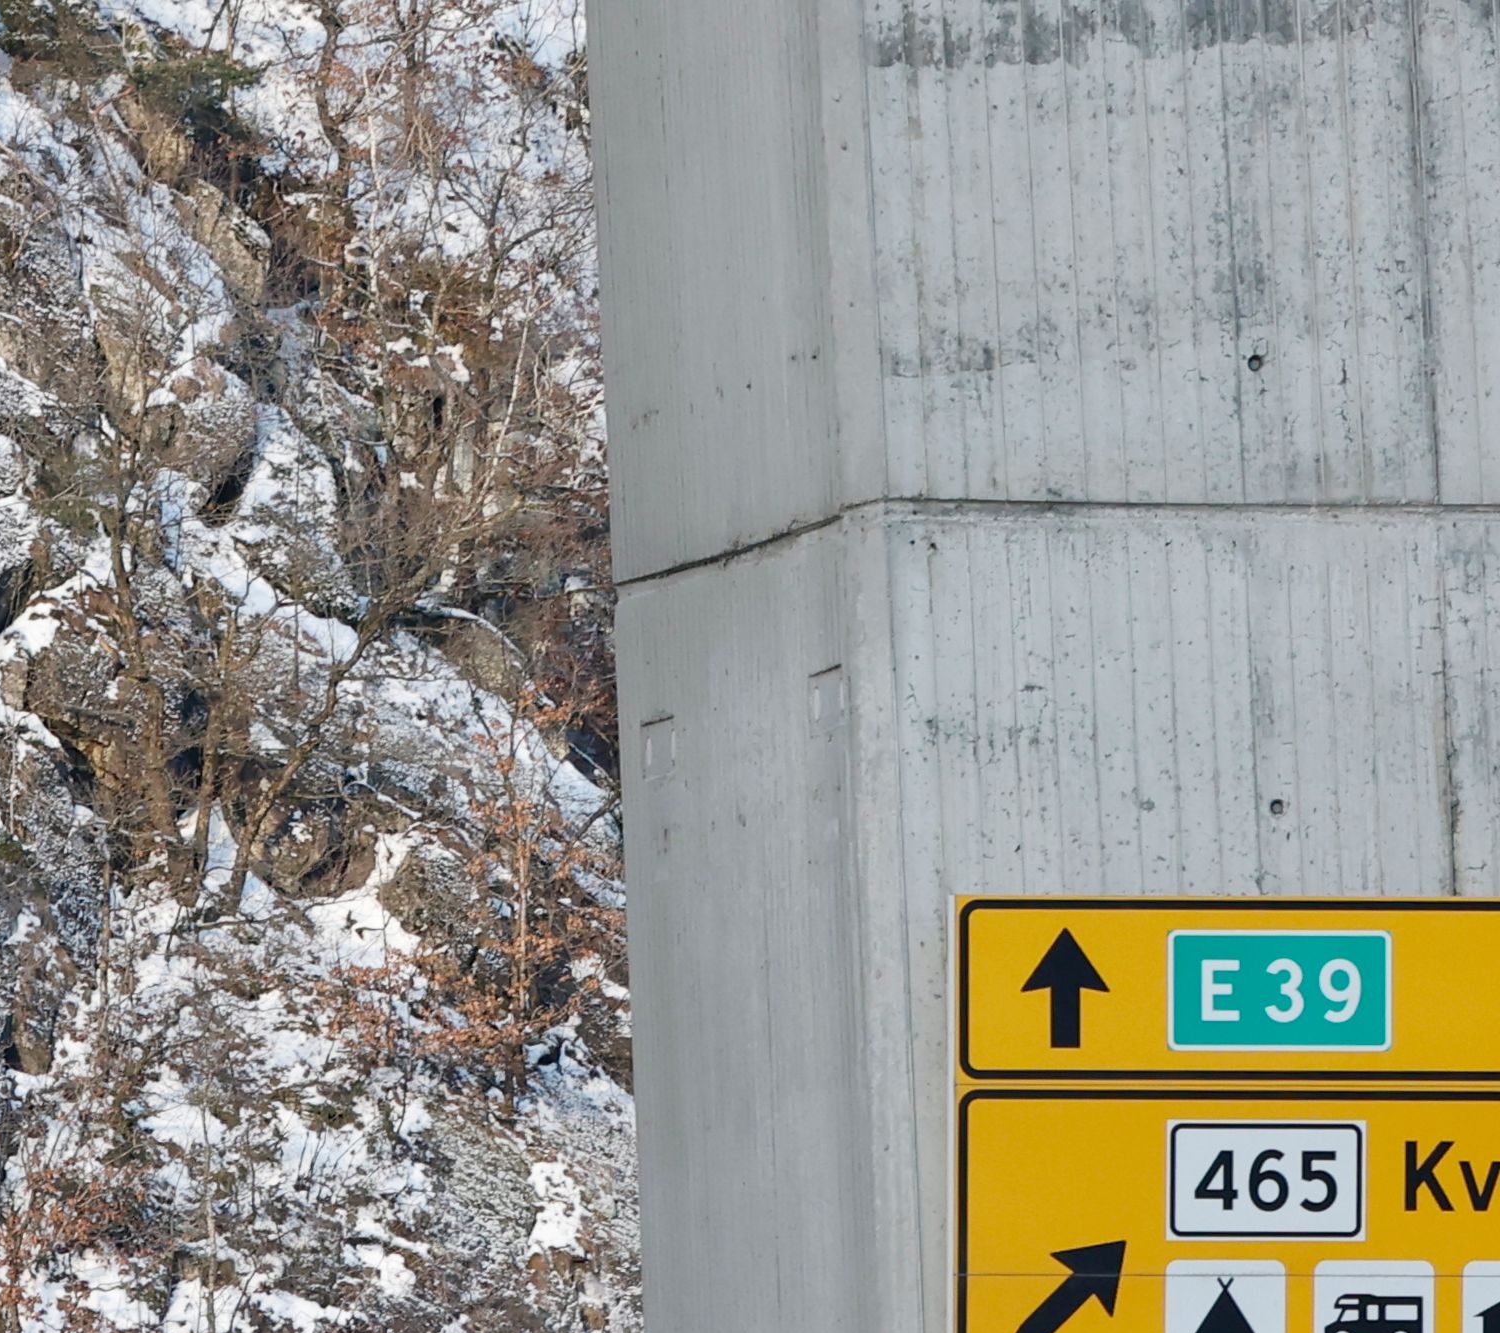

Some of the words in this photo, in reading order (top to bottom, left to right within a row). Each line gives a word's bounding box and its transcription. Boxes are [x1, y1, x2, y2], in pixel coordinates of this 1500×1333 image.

[1201, 959, 1240, 1022] E
[1265, 958, 1362, 1023] 39
[1194, 1149, 1338, 1213] 465
